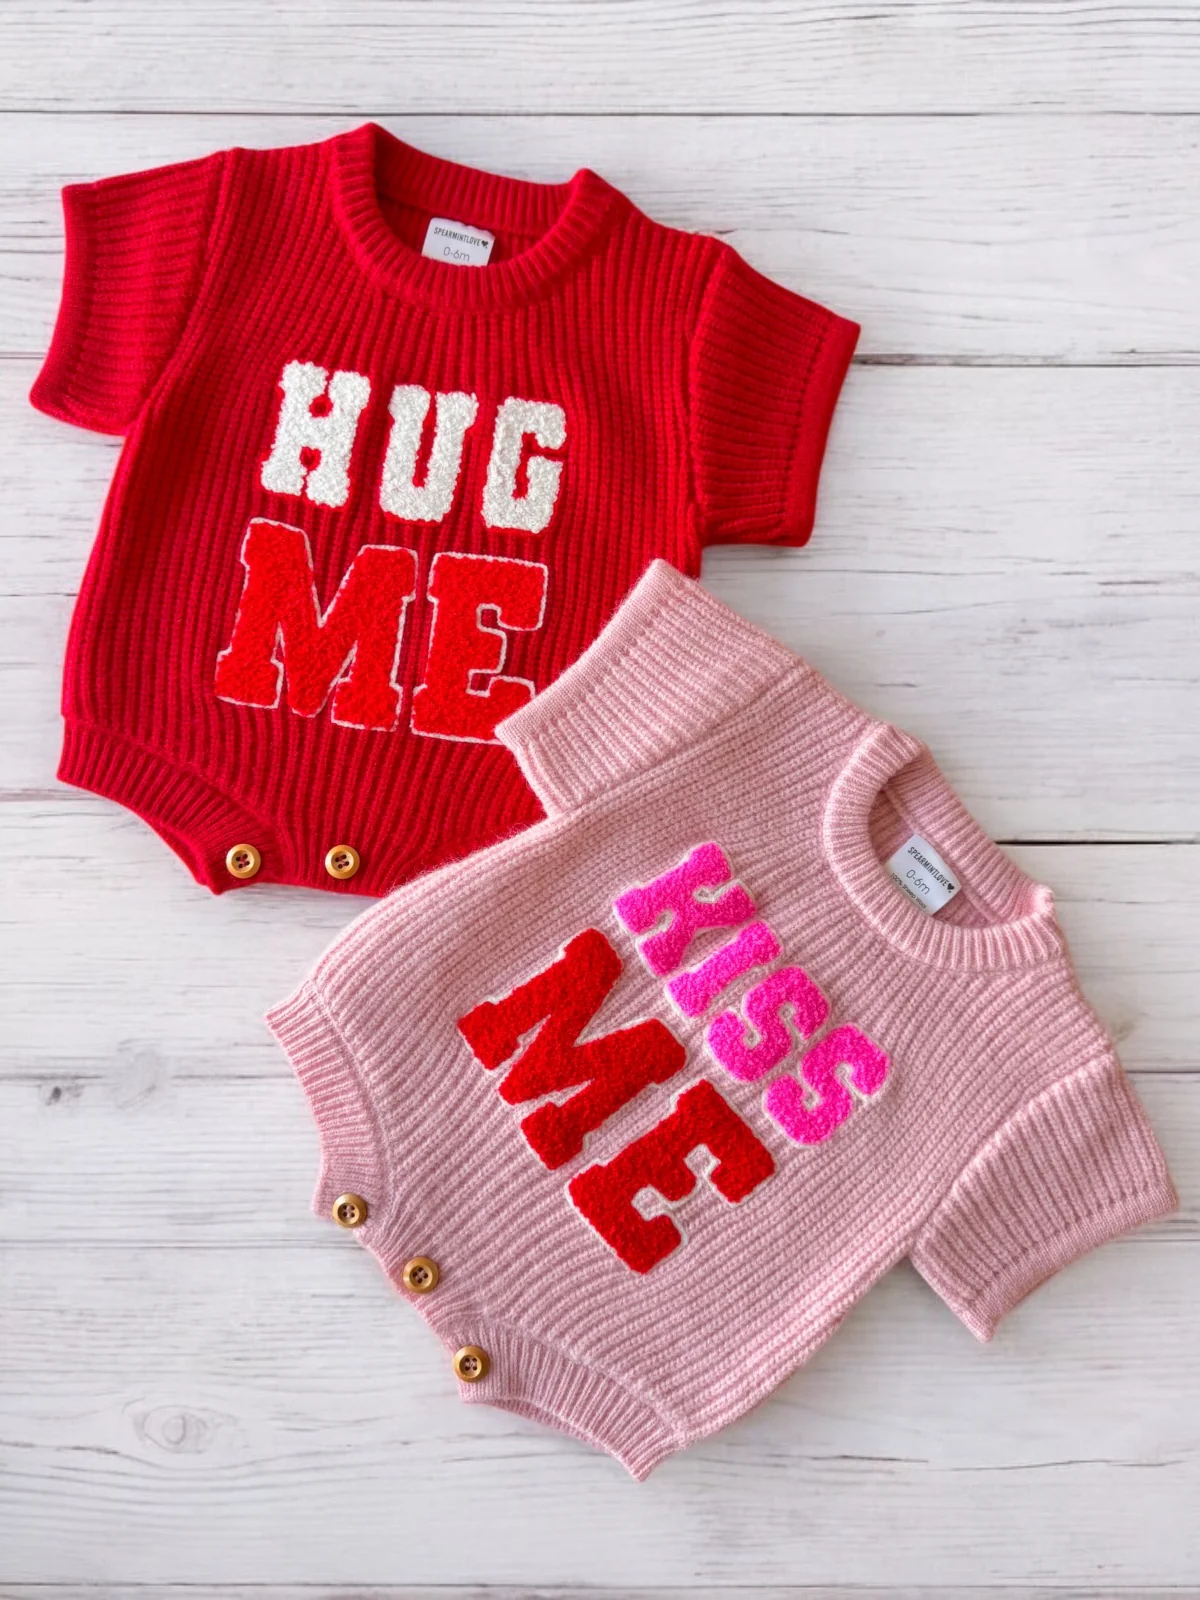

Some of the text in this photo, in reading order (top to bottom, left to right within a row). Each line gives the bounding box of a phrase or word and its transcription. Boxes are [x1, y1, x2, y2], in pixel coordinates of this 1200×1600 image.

[434, 227, 480, 246] SPEARMINTLOVE
[443, 246, 470, 262] 0-6m
[261, 360, 567, 533] HUG
[215, 517, 549, 745] ME
[906, 869, 930, 895] 0-6m
[907, 846, 950, 887] SPEARMINTLOVE
[613, 841, 890, 1146] KISS
[457, 927, 777, 1275] ME
